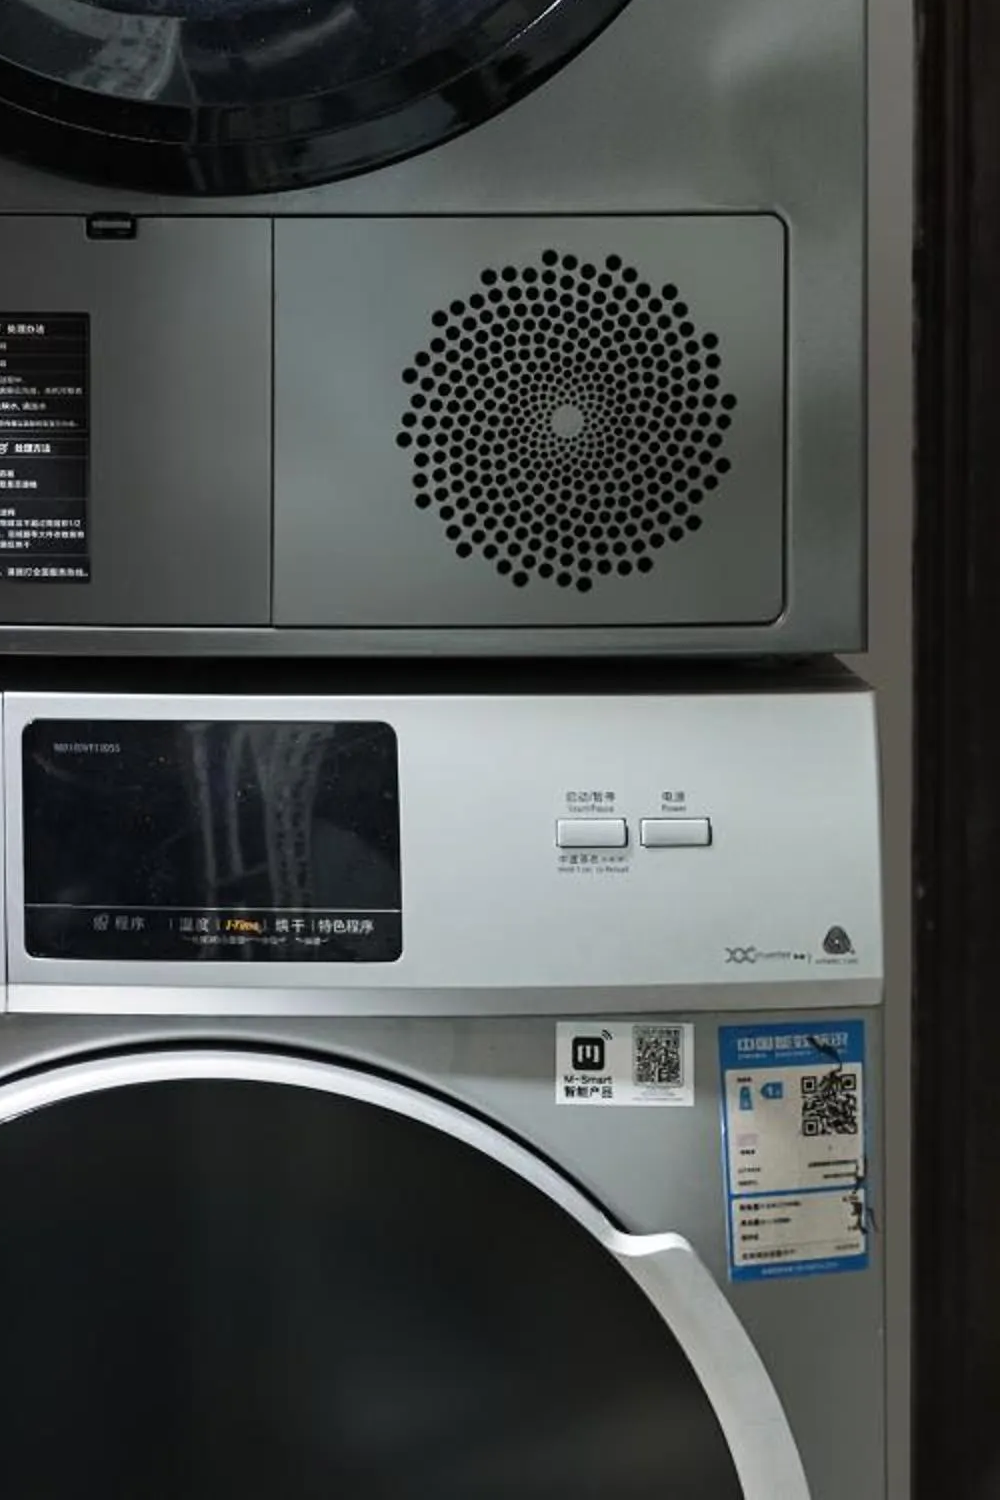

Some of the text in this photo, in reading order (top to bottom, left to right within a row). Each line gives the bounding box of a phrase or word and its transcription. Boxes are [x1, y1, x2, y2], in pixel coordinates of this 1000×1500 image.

[318, 918, 374, 934] 特色程序
[563, 1075, 613, 1084] M-Smart
